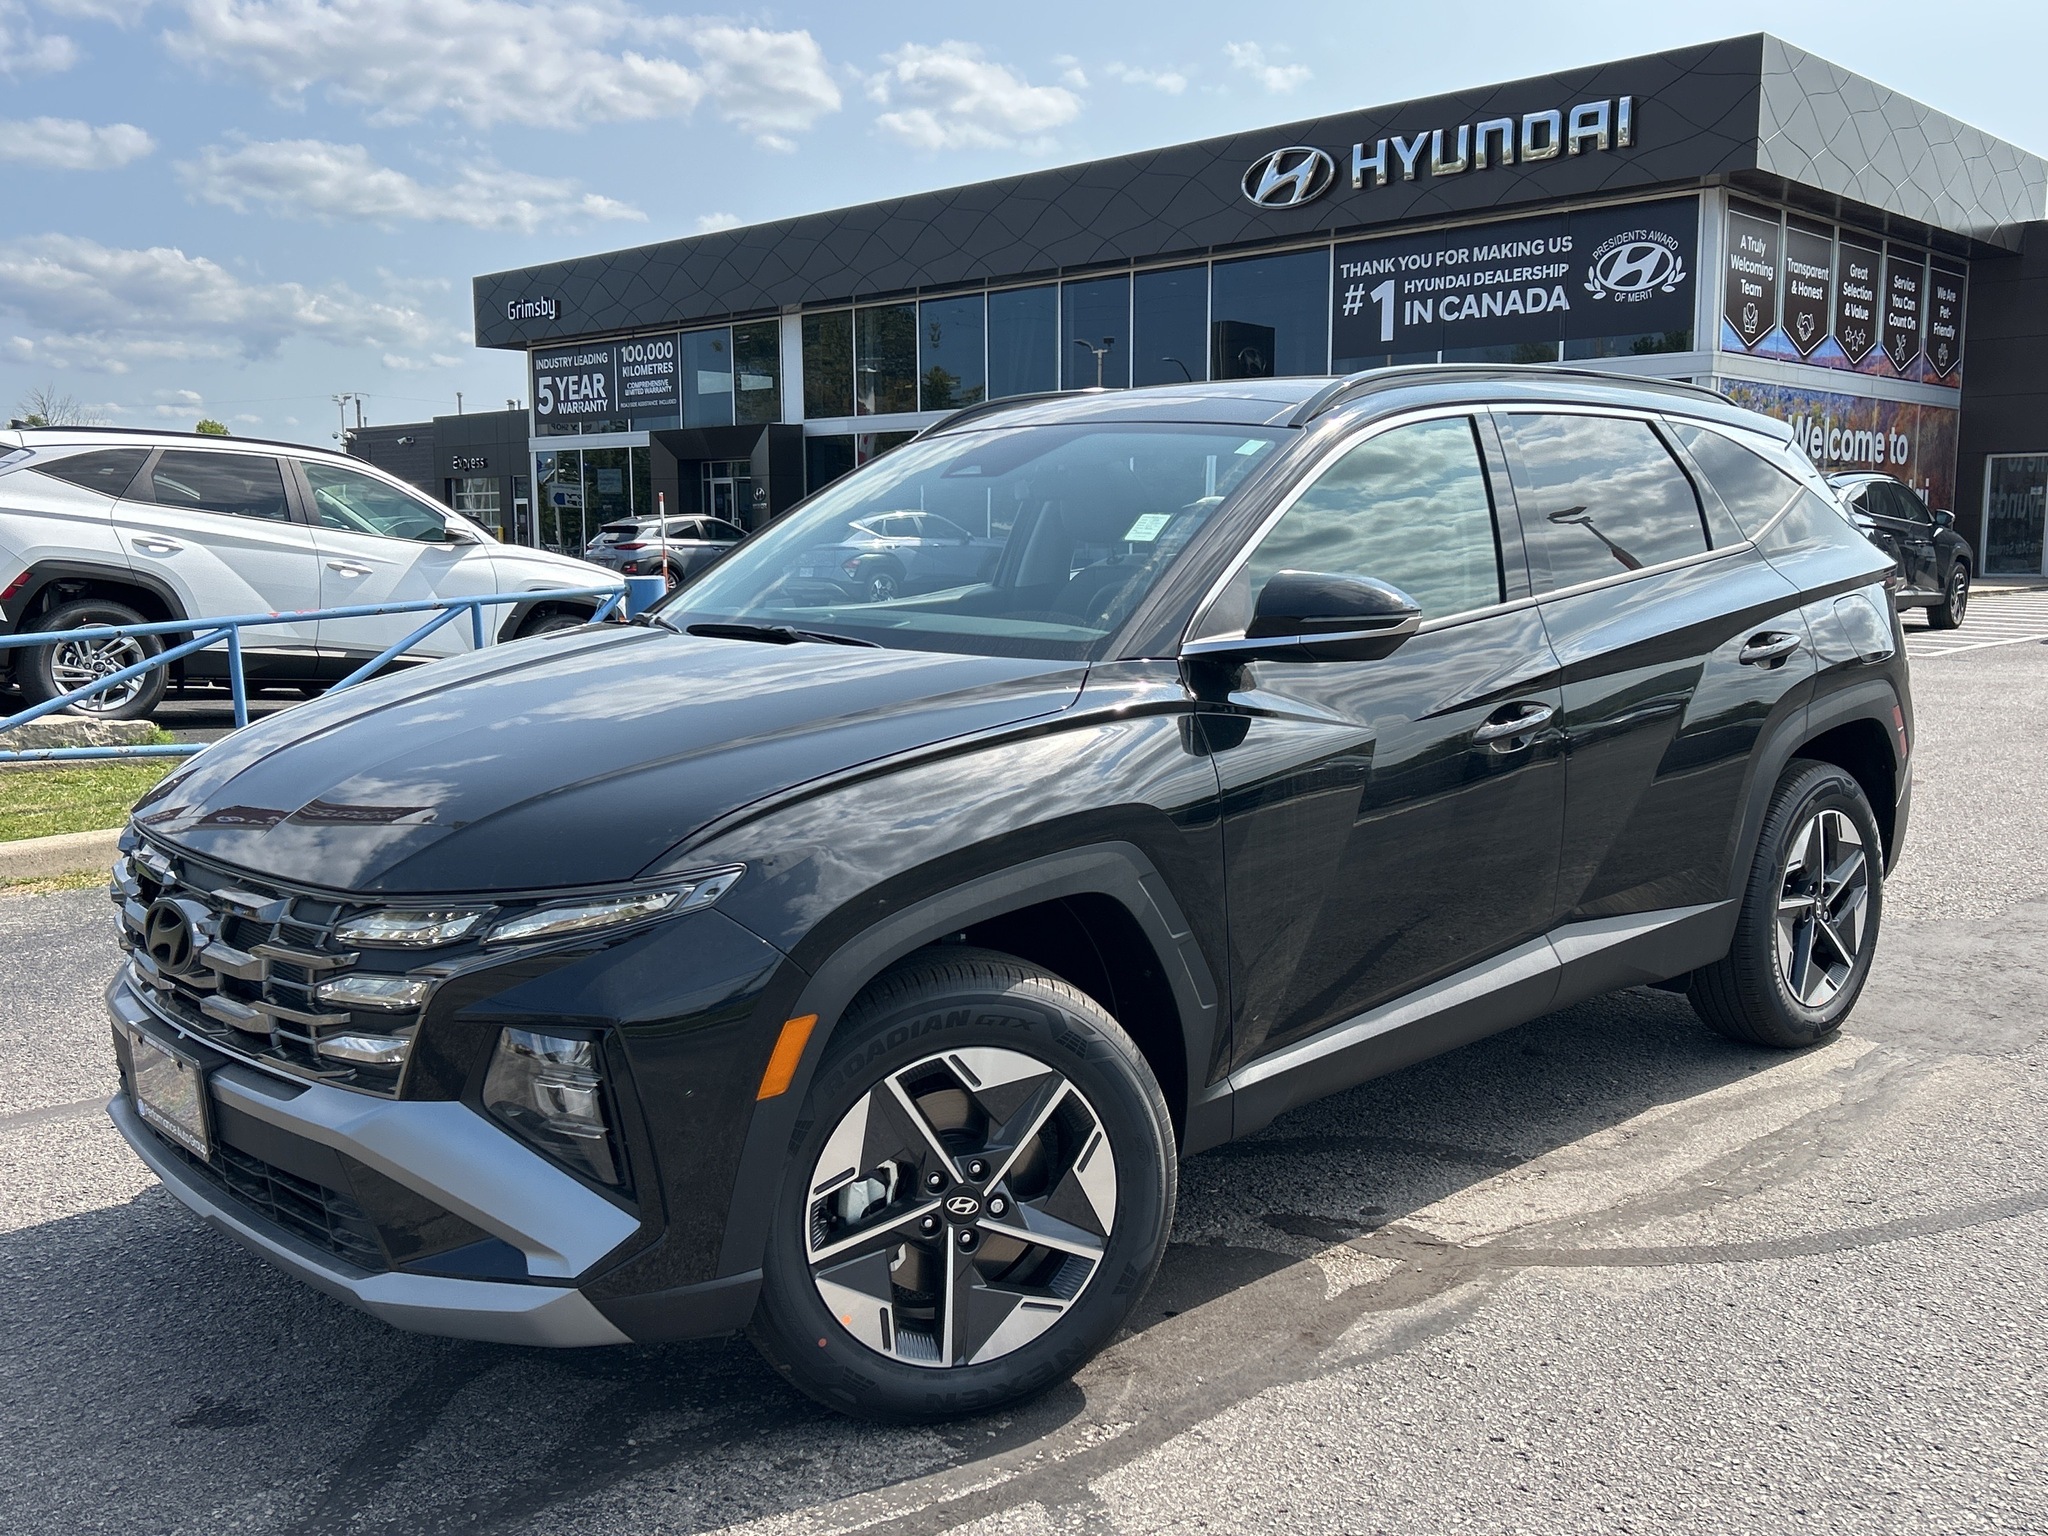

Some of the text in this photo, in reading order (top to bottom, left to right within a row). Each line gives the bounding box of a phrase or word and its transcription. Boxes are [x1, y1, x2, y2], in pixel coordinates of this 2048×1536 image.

[1351, 95, 1633, 190] HYUNDAI
[1592, 229, 1679, 260] PRESIDENT'S AWARD
[1740, 234, 1767, 257] A Truly
[1340, 235, 1573, 279] THANK YOU FOR MAKING US
[1730, 253, 1774, 281] Welcoming
[1404, 263, 1570, 294] HYUNDAI DEALERSHIP
[1787, 257, 1830, 281] Transparent
[1849, 263, 1869, 280] Great
[1740, 279, 1763, 298] Team
[1790, 280, 1824, 301] & Honest
[1842, 281, 1873, 302] Selection
[1893, 274, 1916, 292] Service
[1614, 288, 1654, 303] OF MERIT
[1891, 293, 1916, 312] You Can
[1936, 285, 1957, 303] We Are
[507, 295, 556, 320] Grimsby
[1342, 279, 1396, 342] #1
[1404, 285, 1571, 326] IN CANADA
[1844, 302, 1869, 320] & Value
[1888, 312, 1917, 331] Count On
[1933, 322, 1956, 341] Friendly
[535, 352, 608, 370] INDUSTRY LEADING
[621, 341, 674, 363] 100,000
[622, 361, 674, 378] KILOMETRES
[537, 373, 607, 415] 5 YEAR
[626, 378, 669, 390] COMPREHENSIVE
[644, 384, 673, 395] WARRANTY
[557, 399, 609, 415] WARRANTY
[1787, 414, 1909, 466] Welcome to
[452, 455, 485, 470] Express
[822, 1009, 1038, 1099] ROADIAN GTX
